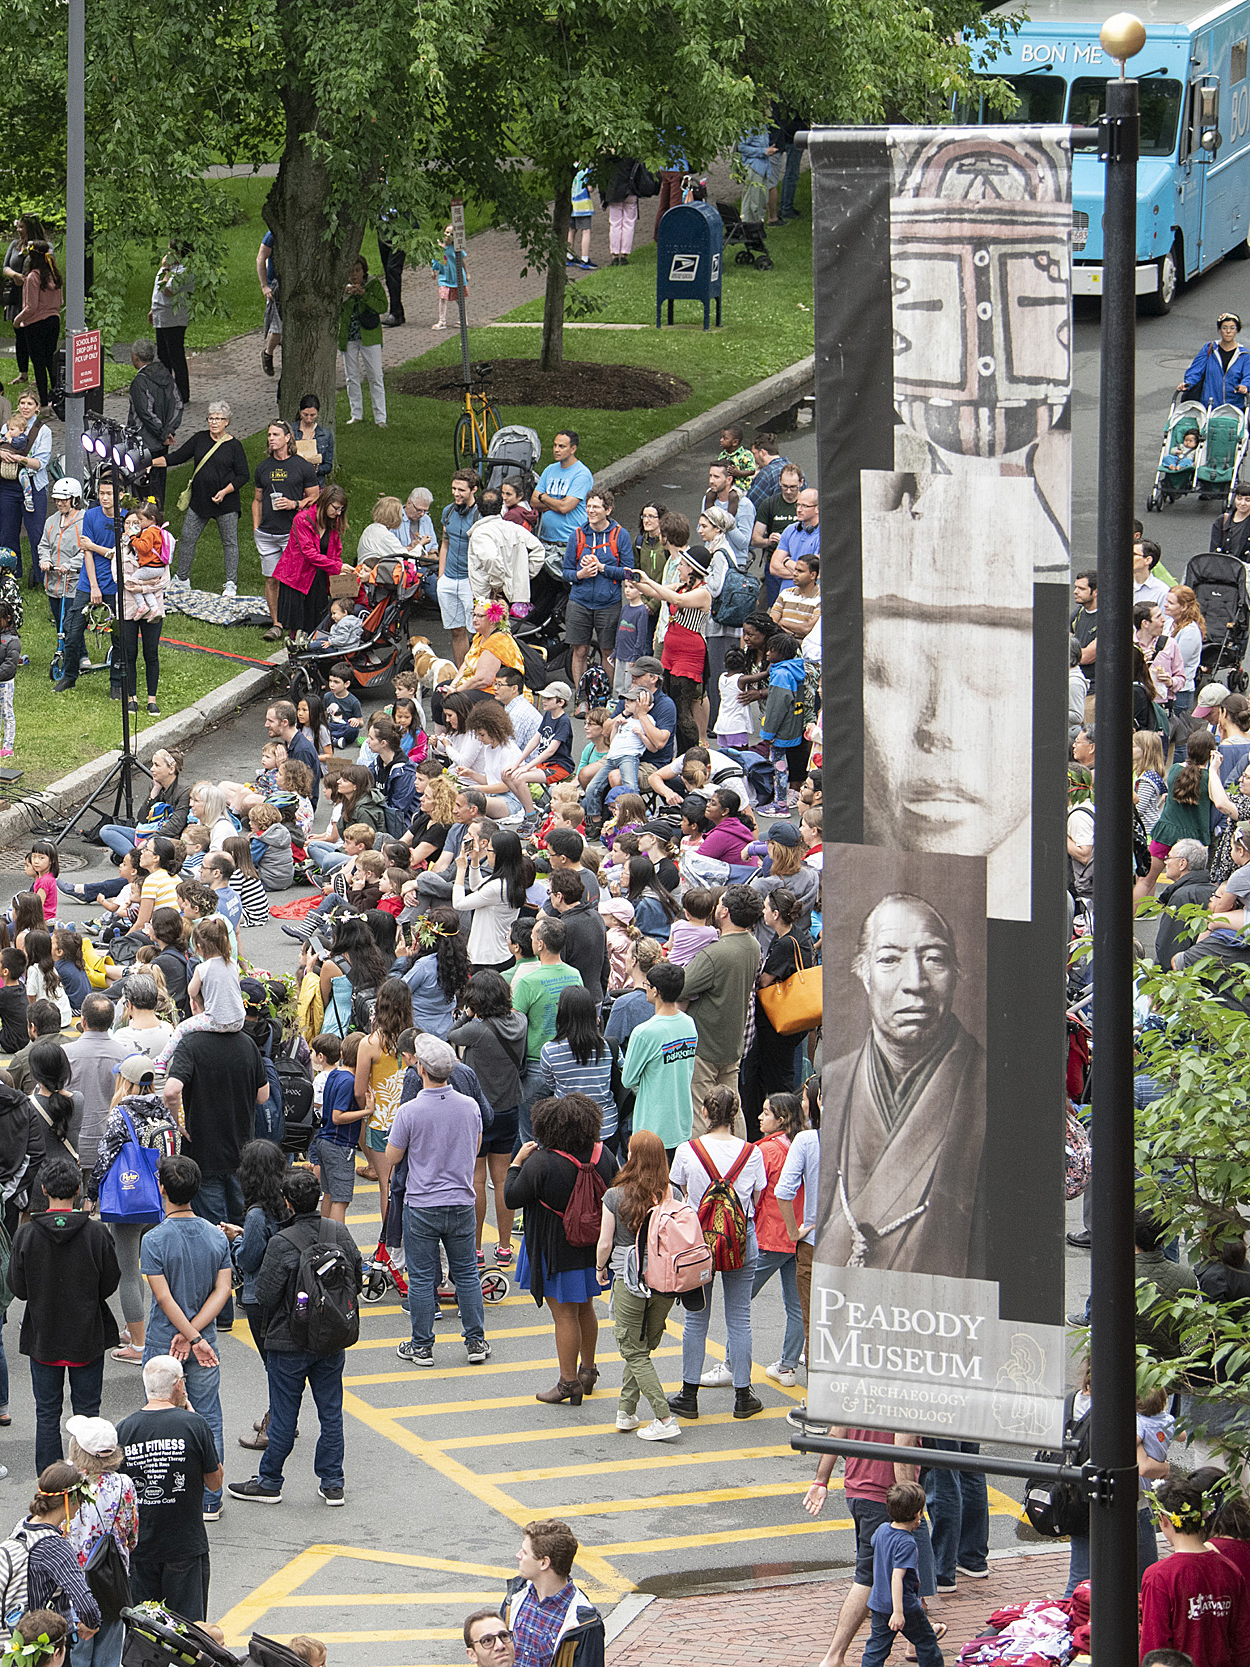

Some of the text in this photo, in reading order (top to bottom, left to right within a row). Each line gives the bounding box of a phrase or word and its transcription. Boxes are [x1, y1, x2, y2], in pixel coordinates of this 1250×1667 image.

[1021, 44, 1104, 65] BON ME
[1230, 85, 1250, 144] BO
[76, 335, 98, 347] SCHOOL BUS
[76, 346, 87, 355] DROP
[88, 352, 98, 360] ONLY
[816, 1286, 986, 1341] PEABODY
[814, 1326, 983, 1381] MUSEUM
[853, 1378, 970, 1407] ARCHAEOLOGY
[841, 1396, 957, 1424] & ETHNOLOGY
[124, 1438, 186, 1457] B&T FITNESS
[1188, 1594, 1231, 1620] HARVARD
